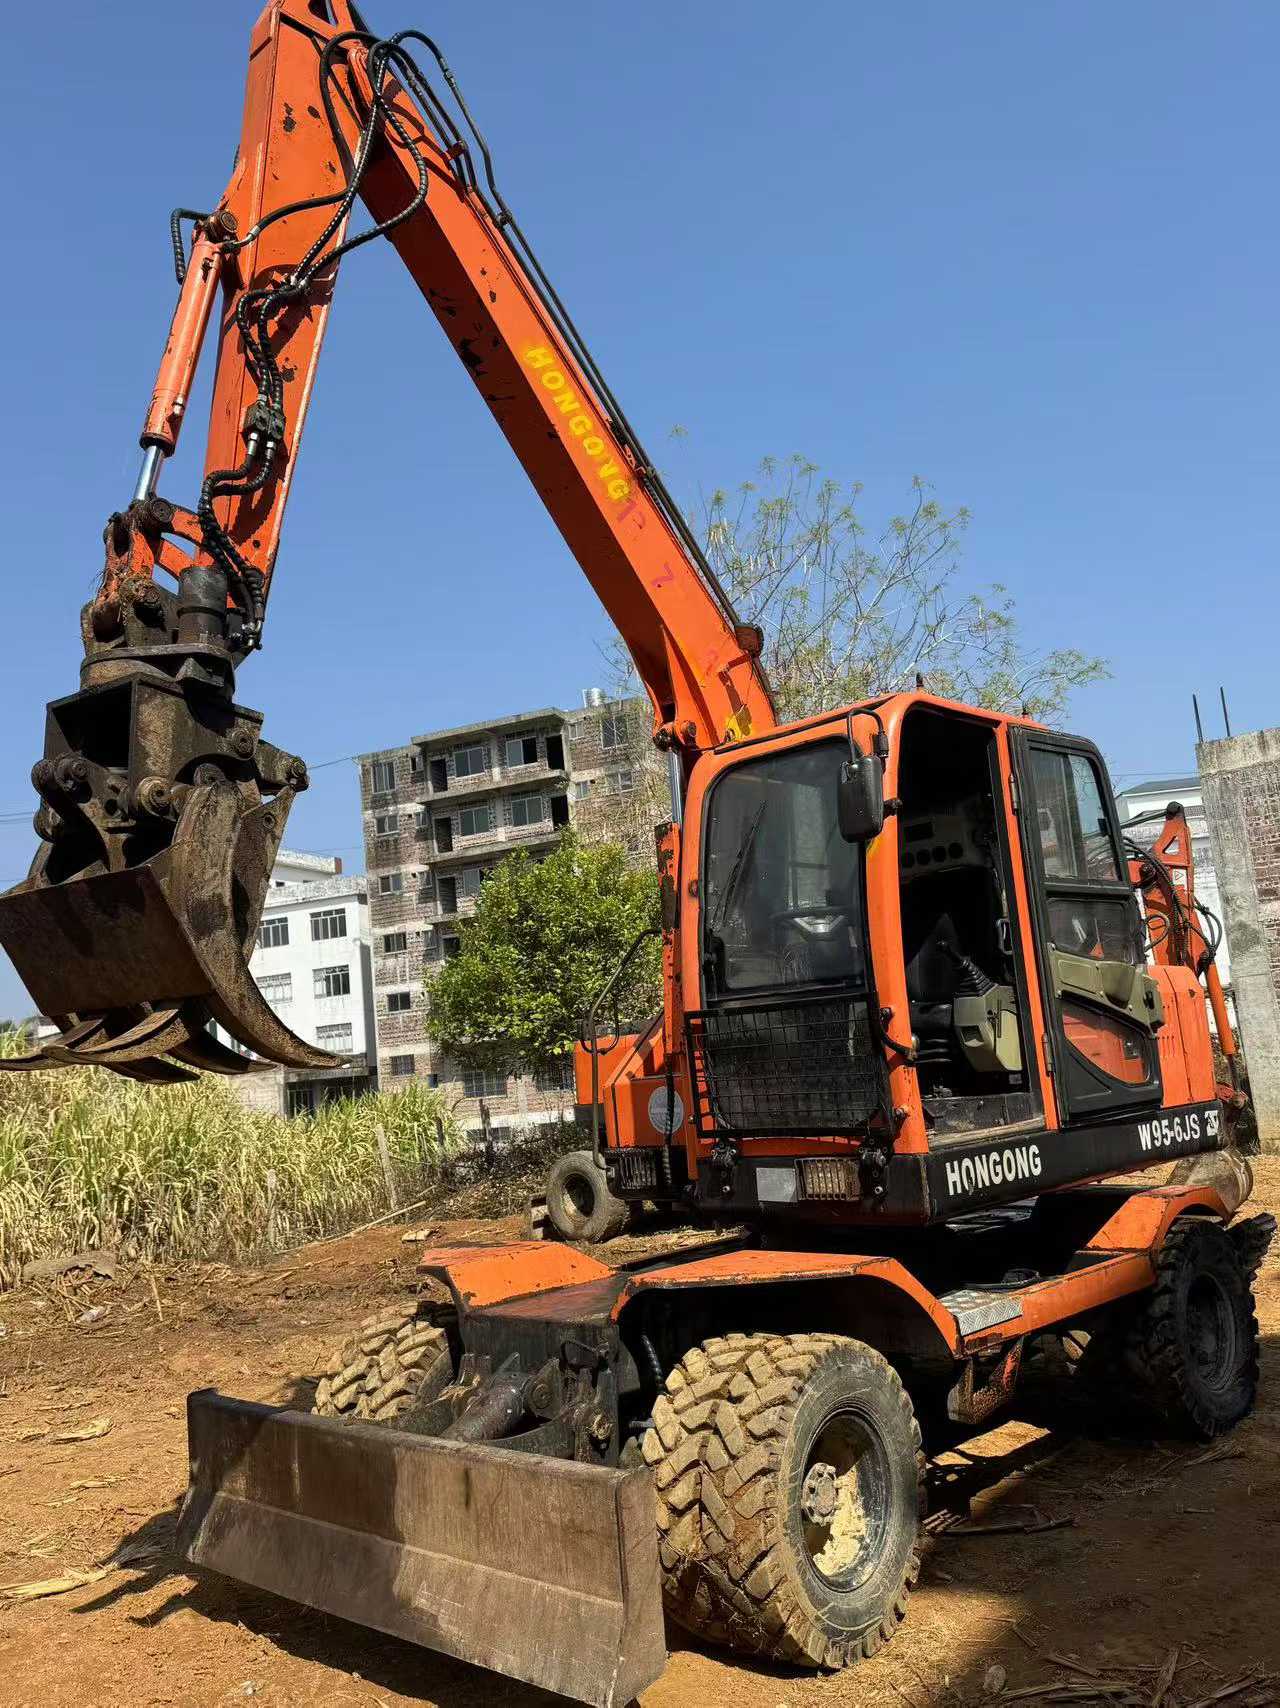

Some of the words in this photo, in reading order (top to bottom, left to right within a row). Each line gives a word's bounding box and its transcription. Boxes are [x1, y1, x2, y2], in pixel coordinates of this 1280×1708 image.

[525, 345, 630, 501] HONGONG
[1138, 1113, 1200, 1151] W95-6JS
[945, 1144, 1042, 1196] HONGONG
